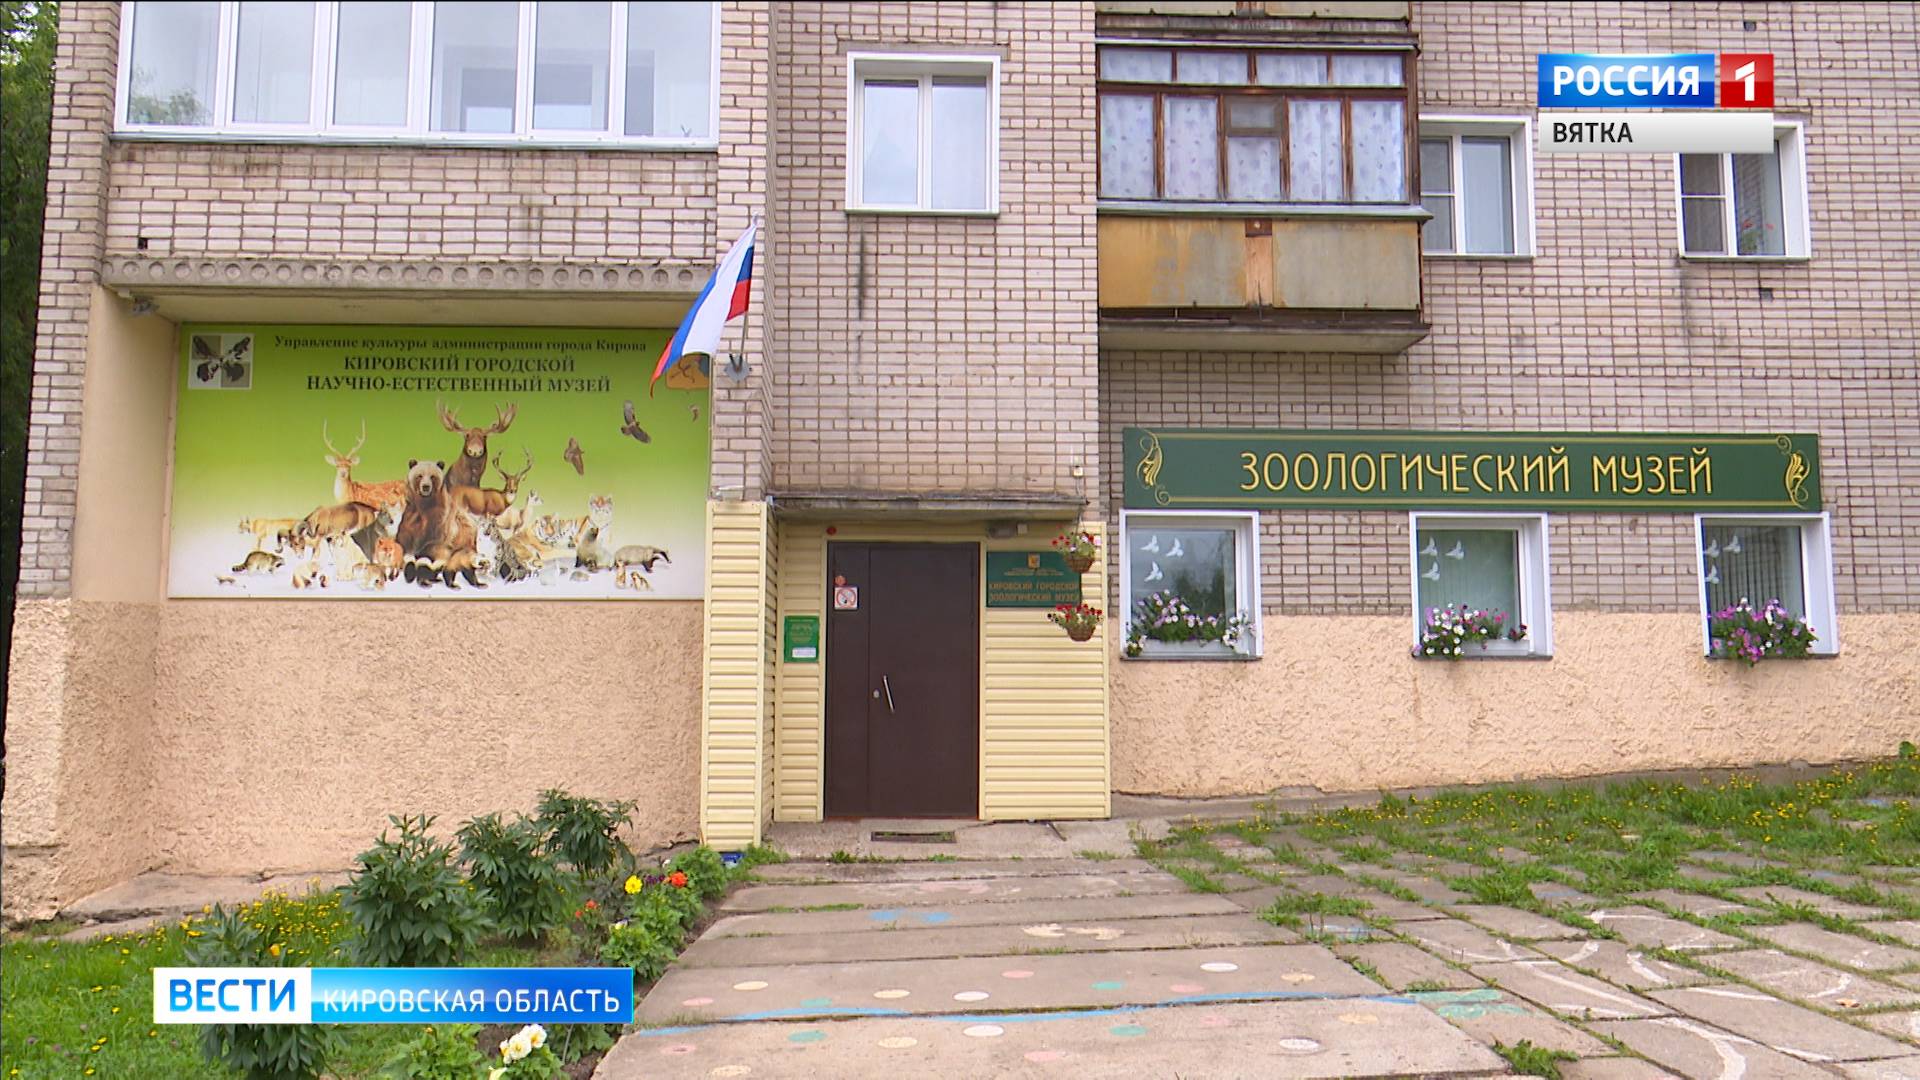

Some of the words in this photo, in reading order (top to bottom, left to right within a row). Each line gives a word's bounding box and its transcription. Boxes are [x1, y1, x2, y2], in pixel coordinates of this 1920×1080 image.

[274, 335, 359, 348] Управление
[362, 337, 427, 350] культуры
[432, 338, 543, 351] администрации
[547, 341, 592, 352] города
[596, 339, 646, 353] Кирова
[344, 353, 460, 371] КИРОВСКИЙ
[465, 354, 575, 373] ГОРОДСКОЙ
[307, 375, 542, 392] НАУЧНО-ЕСТЕСТВЕННЫЙ
[547, 375, 611, 393] МУЗЕЙ
[1239, 445, 1573, 493] ЗООЛОГИЧЕСКИЙ
[1592, 445, 1713, 495] МУЗЕЙ
